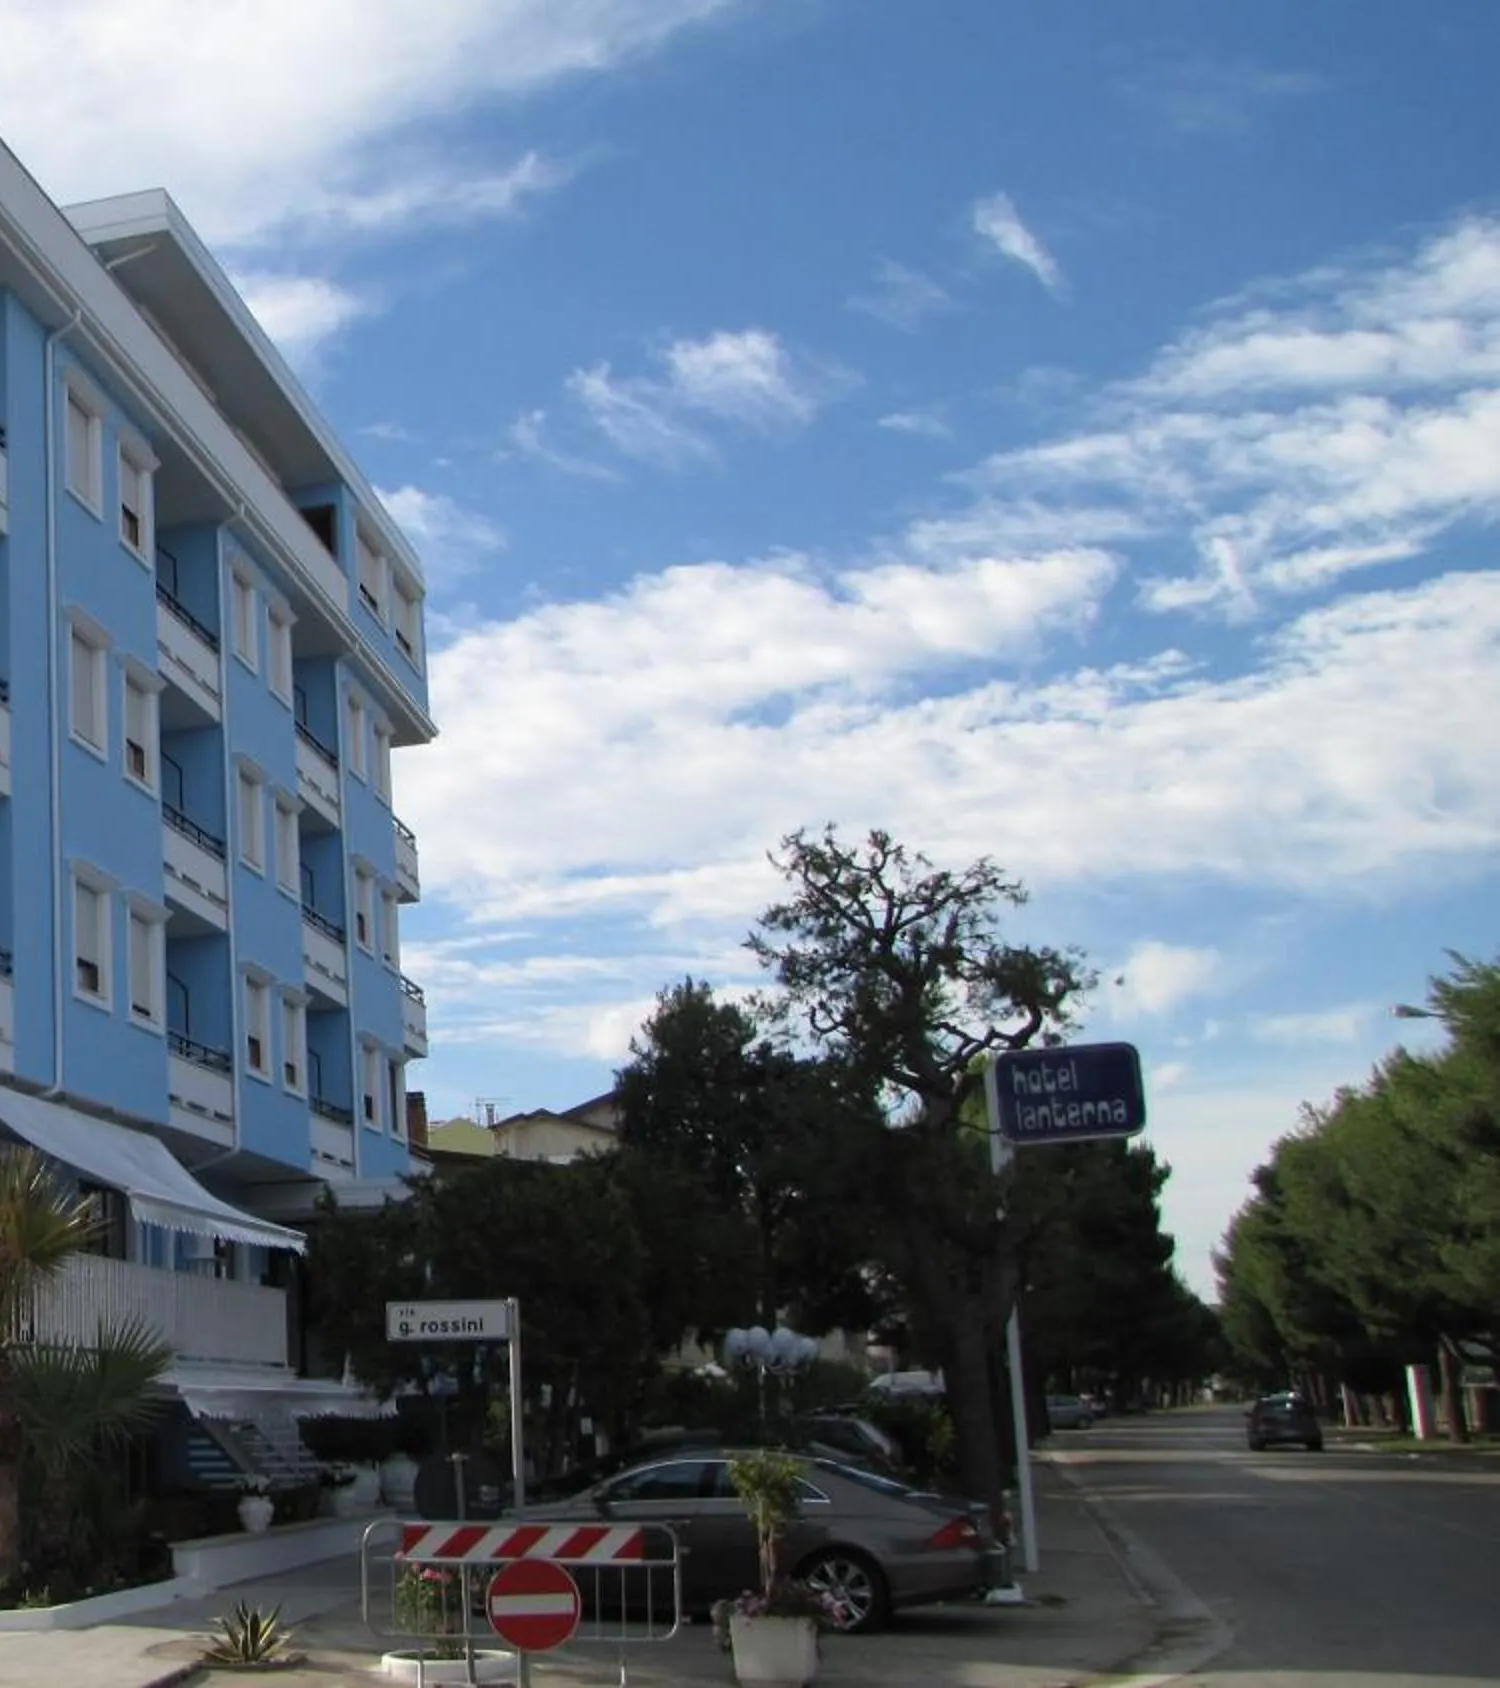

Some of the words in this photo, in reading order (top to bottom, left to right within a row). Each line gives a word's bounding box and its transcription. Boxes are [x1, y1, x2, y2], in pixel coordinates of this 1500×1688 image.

[1012, 1060, 1078, 1095] hotel
[1016, 1098, 1127, 1131] lanterna
[420, 1316, 484, 1334] rossini
